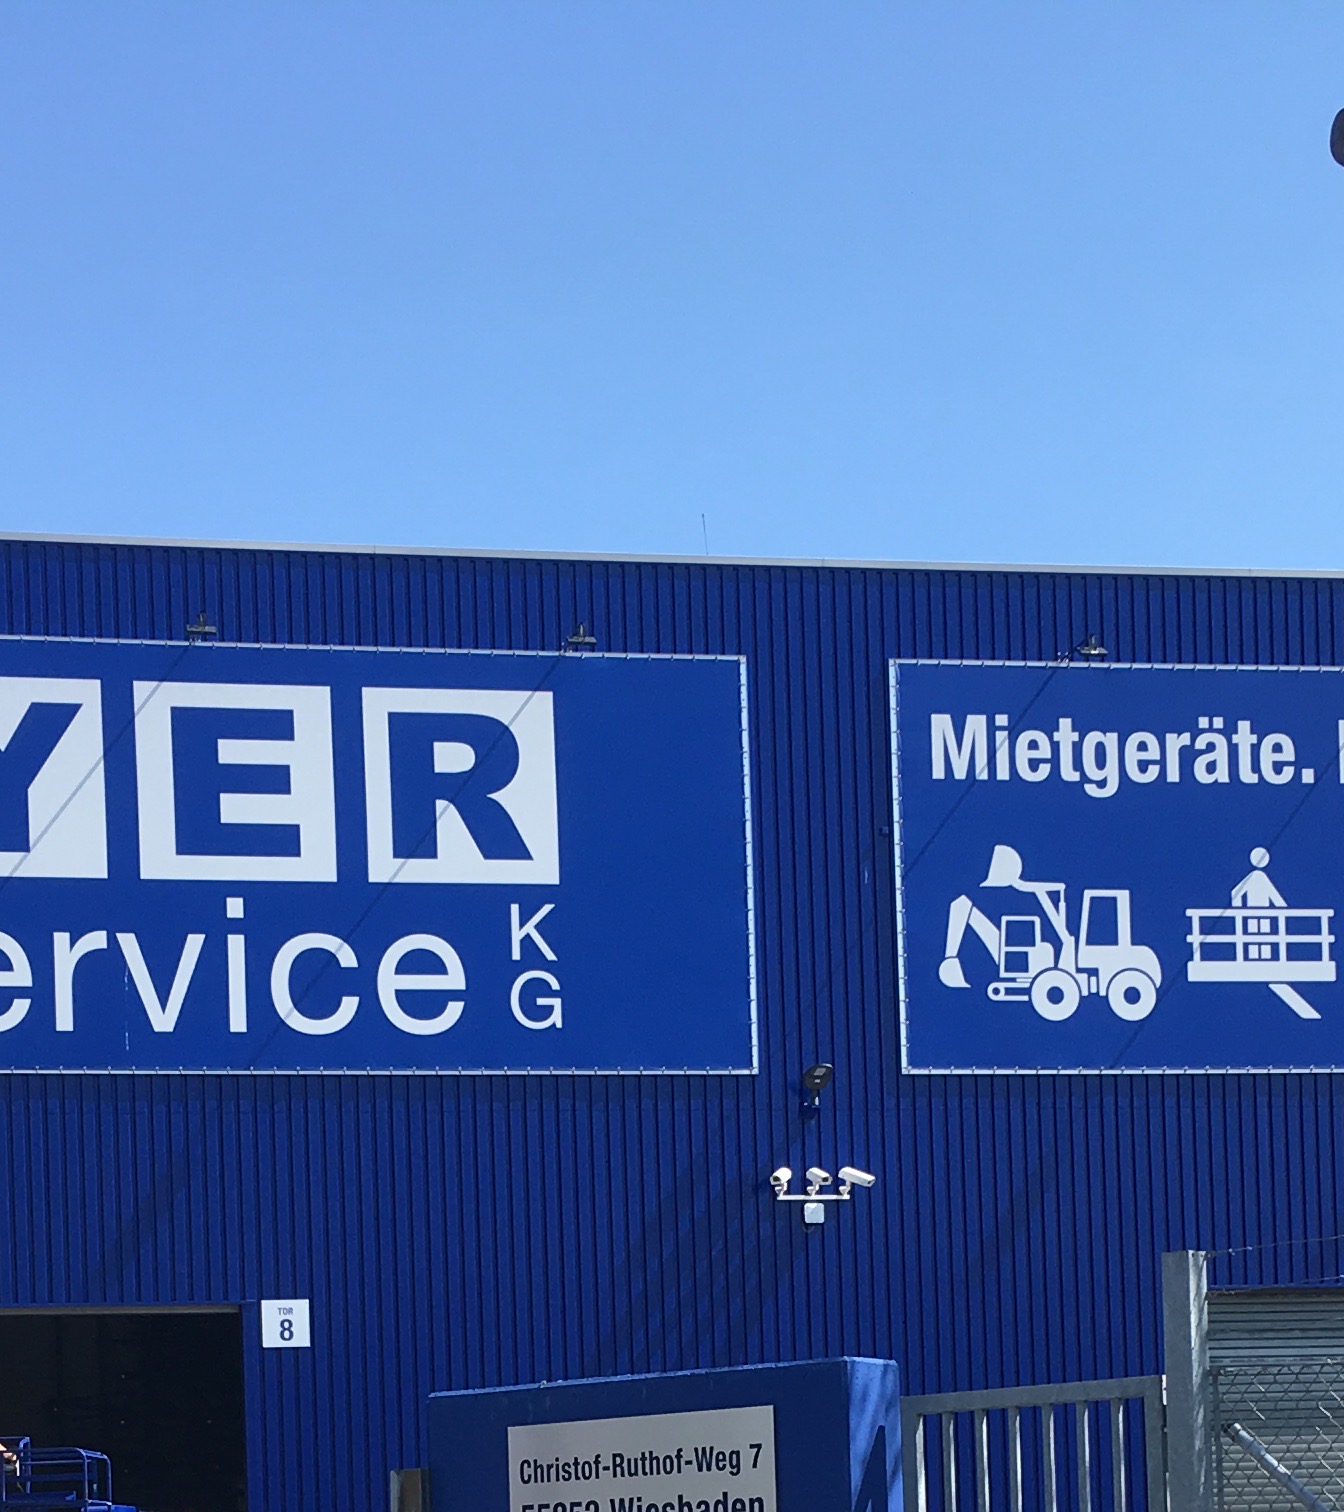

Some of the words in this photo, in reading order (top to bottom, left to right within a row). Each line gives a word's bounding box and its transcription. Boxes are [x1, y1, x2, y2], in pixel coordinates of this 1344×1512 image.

[931, 713, 1314, 798] Mietgeräte.
[277, 1307, 293, 1315] TOR
[279, 1318, 294, 1341] 8
[519, 1446, 740, 1484] Christof-Ruthof-Weg
[749, 1443, 763, 1469] 7
